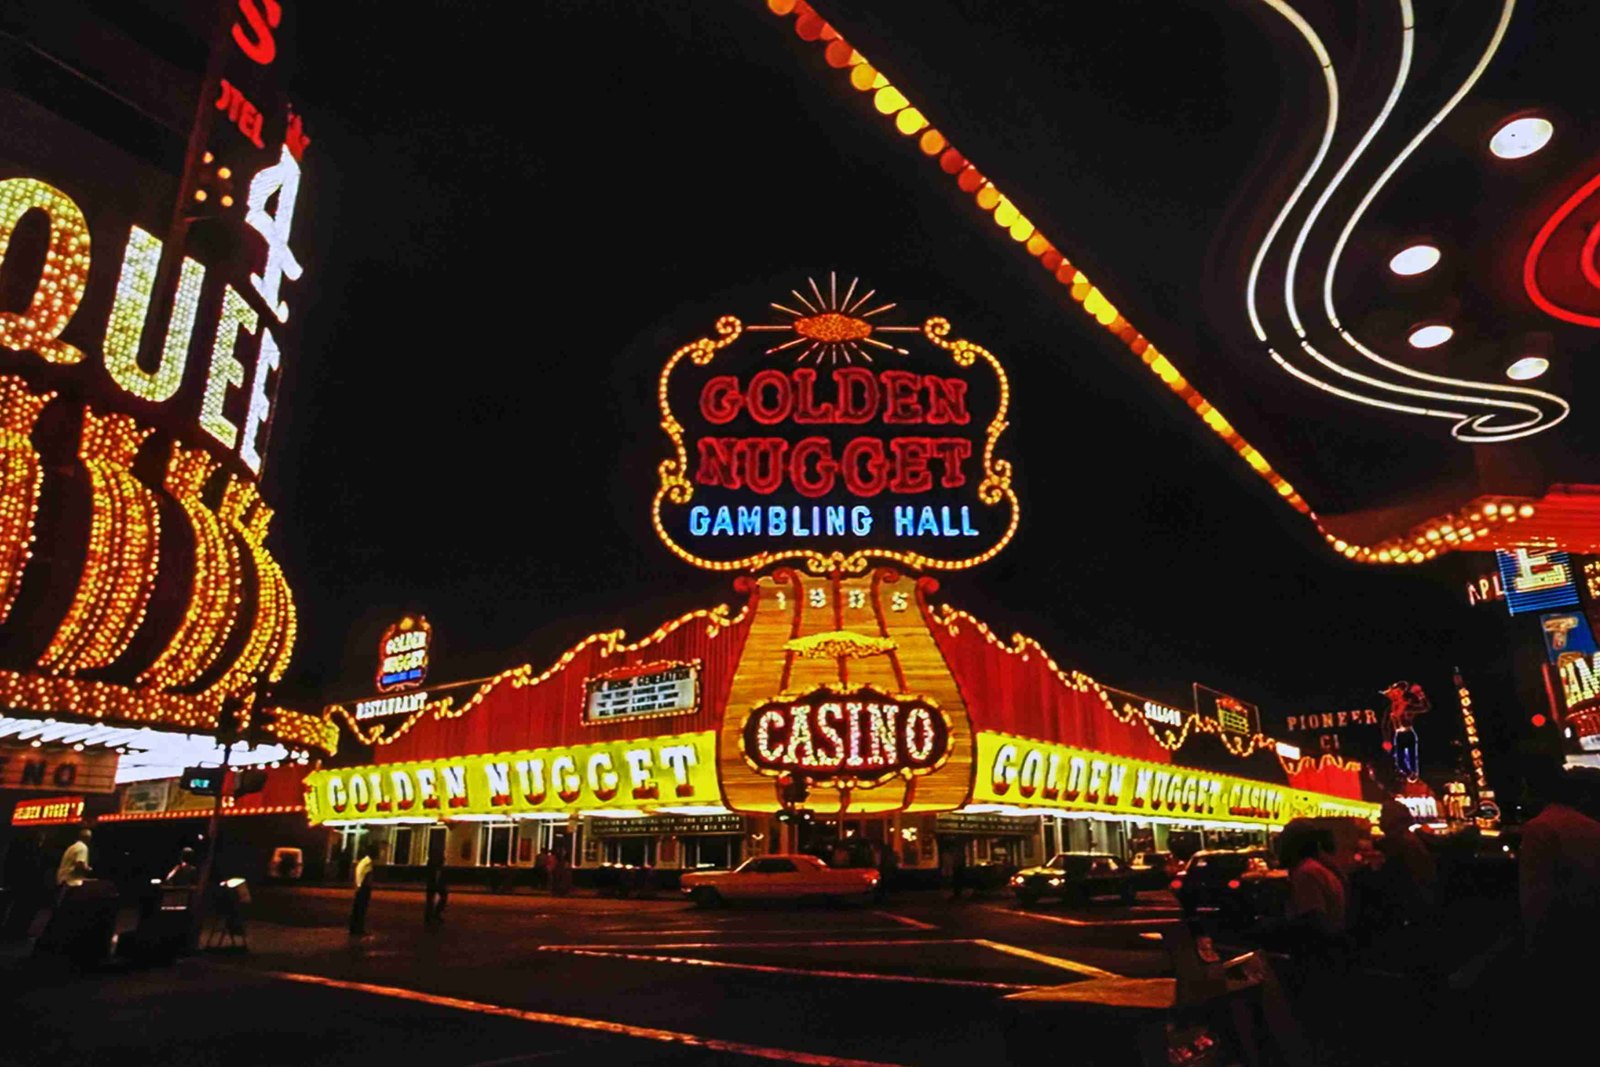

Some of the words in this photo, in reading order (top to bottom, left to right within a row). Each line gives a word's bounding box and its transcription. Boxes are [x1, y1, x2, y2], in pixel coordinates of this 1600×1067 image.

[699, 366, 972, 425] GOLDEN
[695, 436, 972, 498] NUGGET
[688, 505, 873, 537] GAMBLING
[894, 505, 980, 537] HALL
[756, 701, 936, 768] CASINO
[1286, 709, 1377, 732] PIONEER
[326, 764, 471, 814] GOLDEN
[484, 743, 701, 806] NUGGET
[991, 743, 1129, 806] GOLDEN
[1132, 766, 1222, 814] NUGGET
[1228, 783, 1285, 820] CASINO
